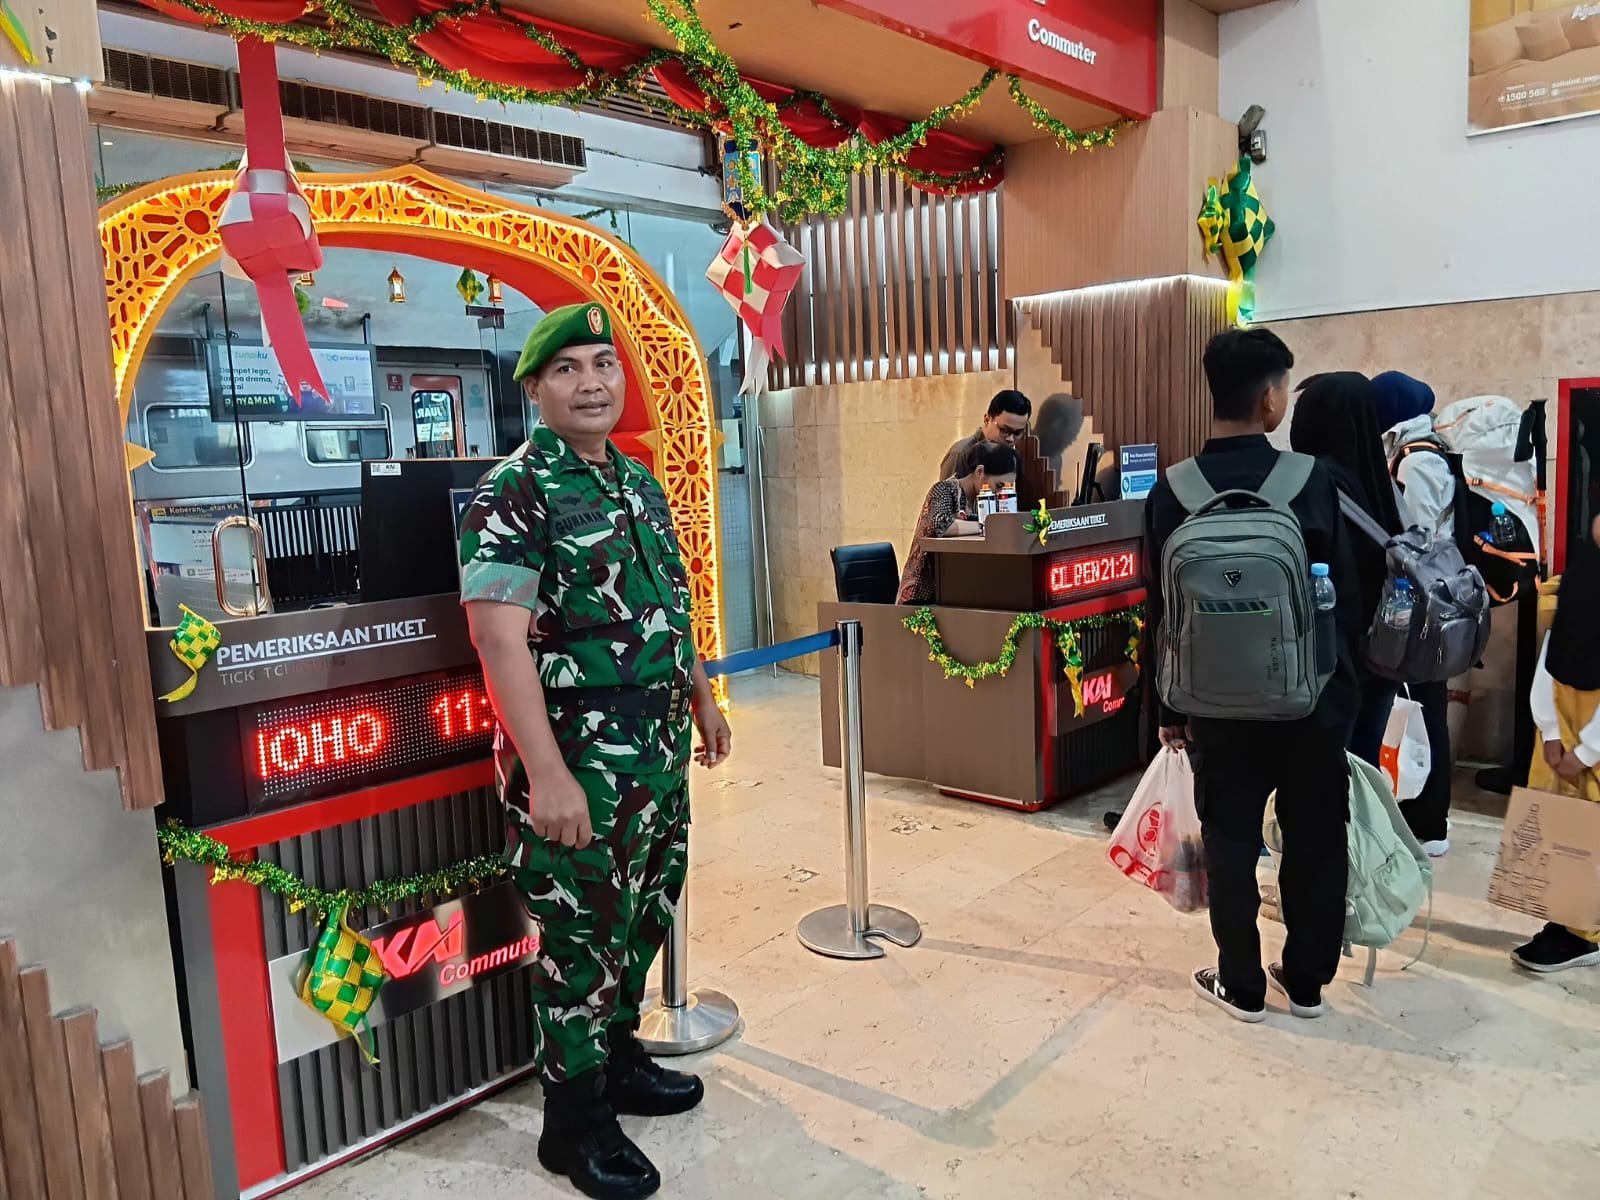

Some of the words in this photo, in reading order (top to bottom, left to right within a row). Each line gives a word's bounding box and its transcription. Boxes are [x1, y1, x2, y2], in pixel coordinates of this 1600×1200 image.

[1028, 18, 1096, 65] Commuter
[169, 504, 227, 515] Keberanatan
[1100, 553, 1133, 581] 21:21
[216, 625, 370, 665] PEMERIKSAAN
[373, 618, 426, 641] TIKET
[1083, 672, 1112, 706] KAI
[371, 910, 464, 979] KAI
[439, 934, 541, 988] Commute
